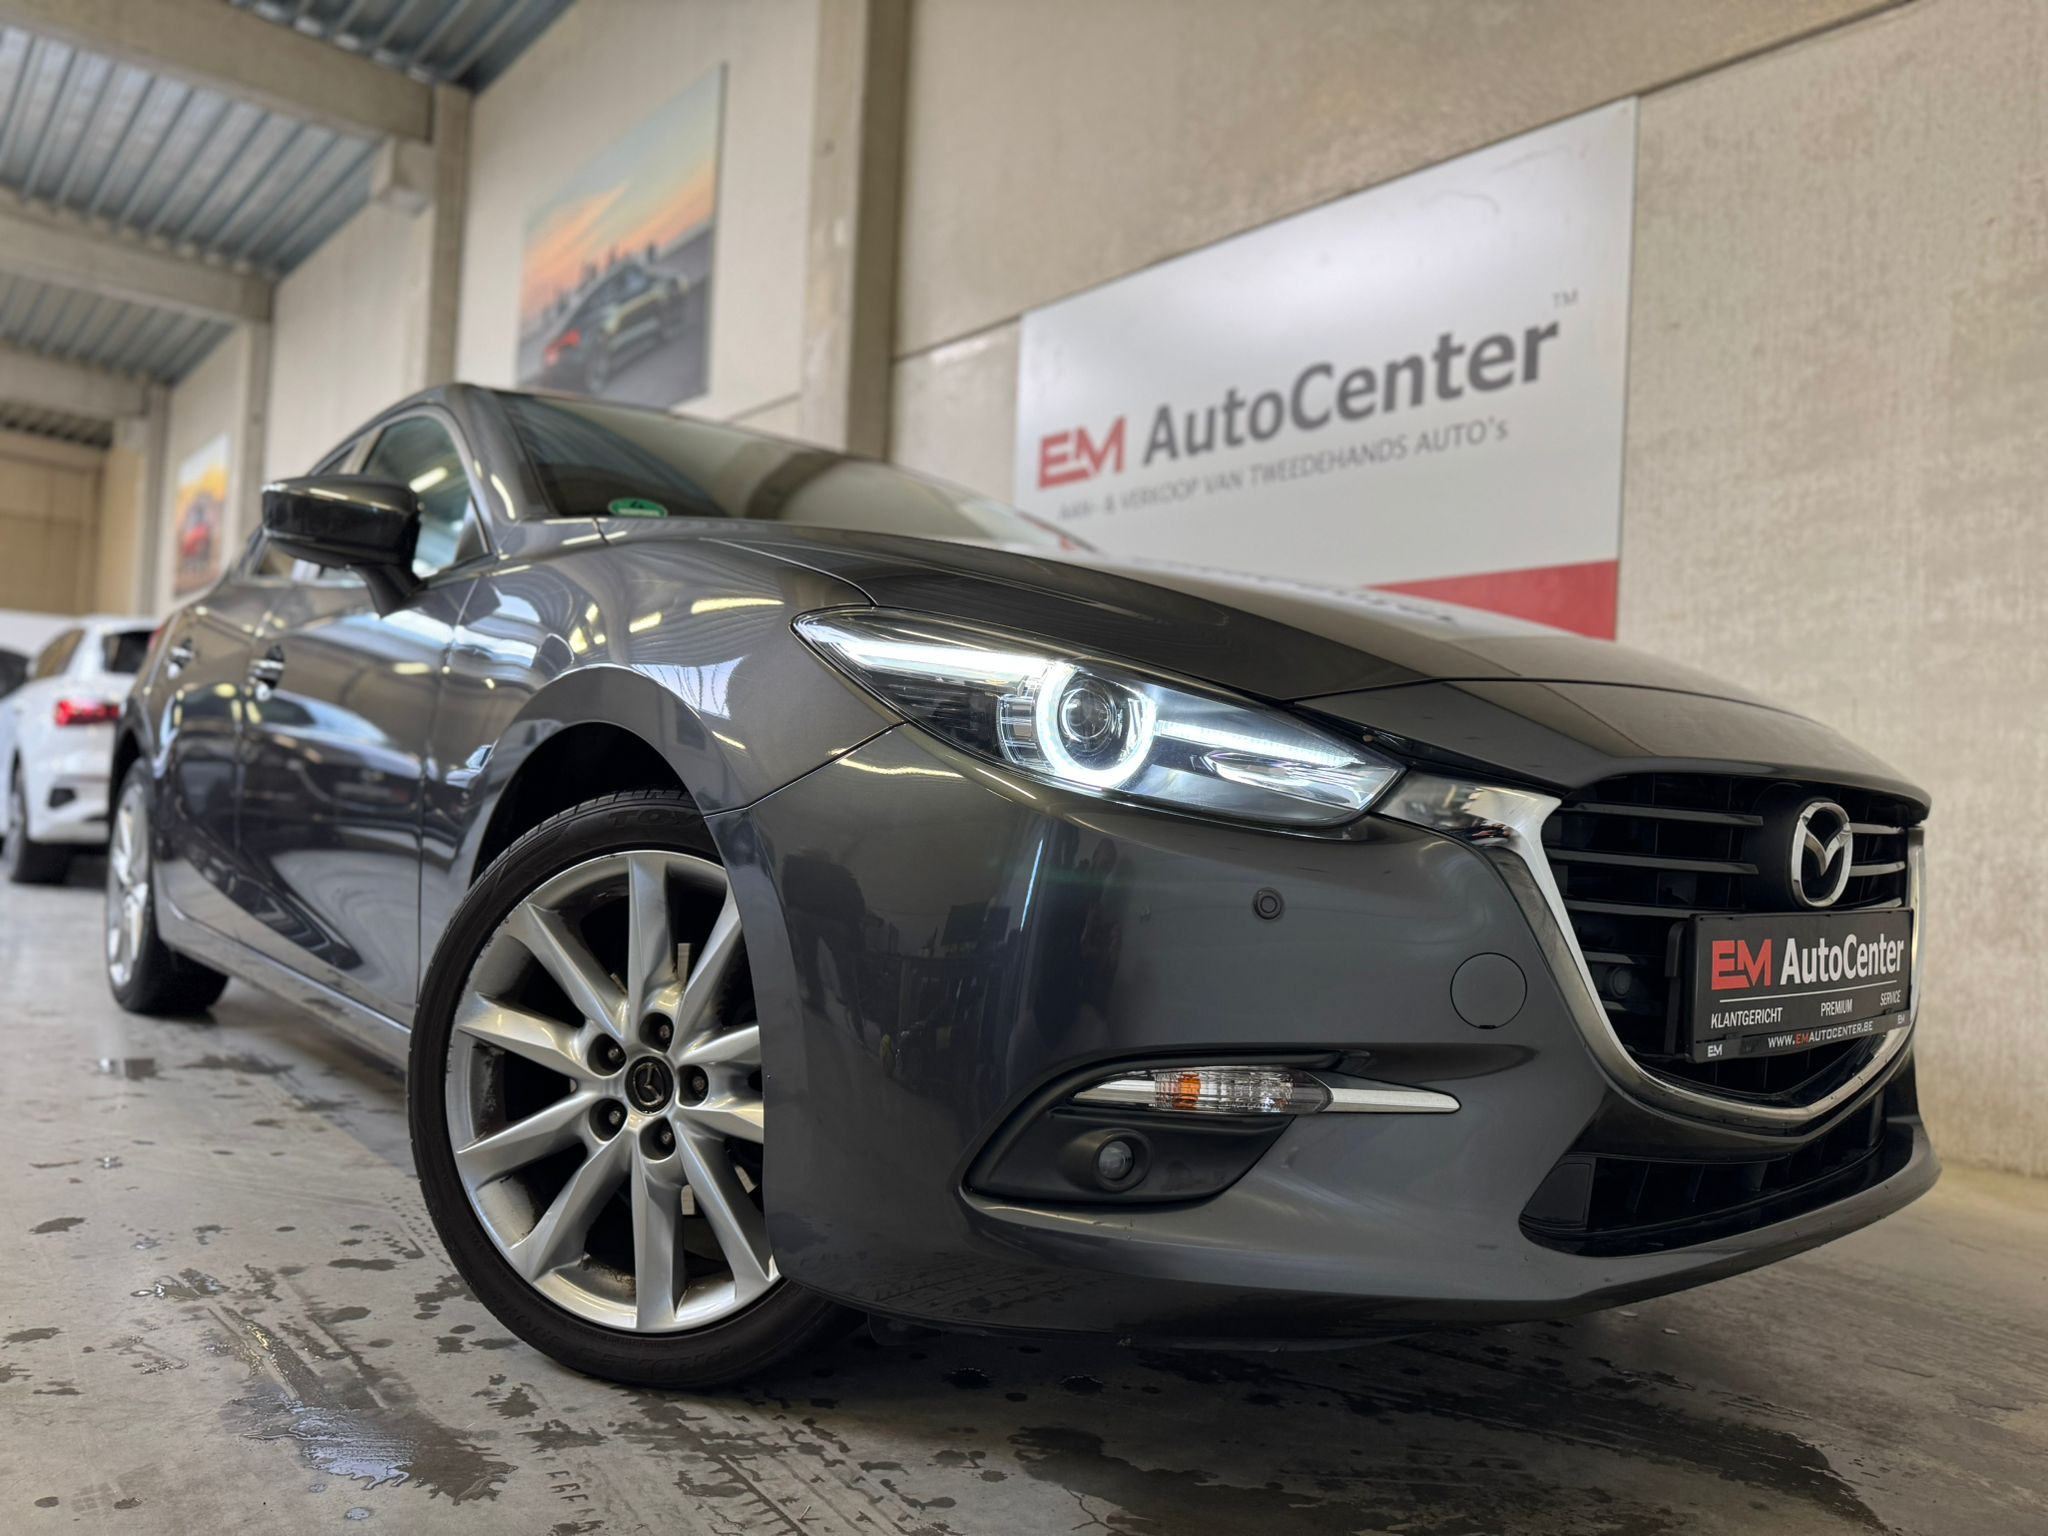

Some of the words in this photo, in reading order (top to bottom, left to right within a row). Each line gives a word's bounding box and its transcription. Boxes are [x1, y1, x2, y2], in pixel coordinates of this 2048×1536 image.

[1038, 415, 1126, 489] EM
[1142, 321, 1559, 467] AutoCenter
[1203, 470, 1244, 495] VAN
[1249, 433, 1409, 488] TWEEDEHANDS
[1711, 938, 1772, 991] EM
[1780, 933, 1905, 986] AutoCenter
[1710, 1007, 1783, 1030] KLANTGERICHT
[1820, 998, 1853, 1017] PREMIUM
[1879, 989, 1902, 1007] SERVICE
[1707, 1043, 1723, 1058] EM
[1767, 1020, 1874, 1050] WWW.EMAUTOCENTER.BE
